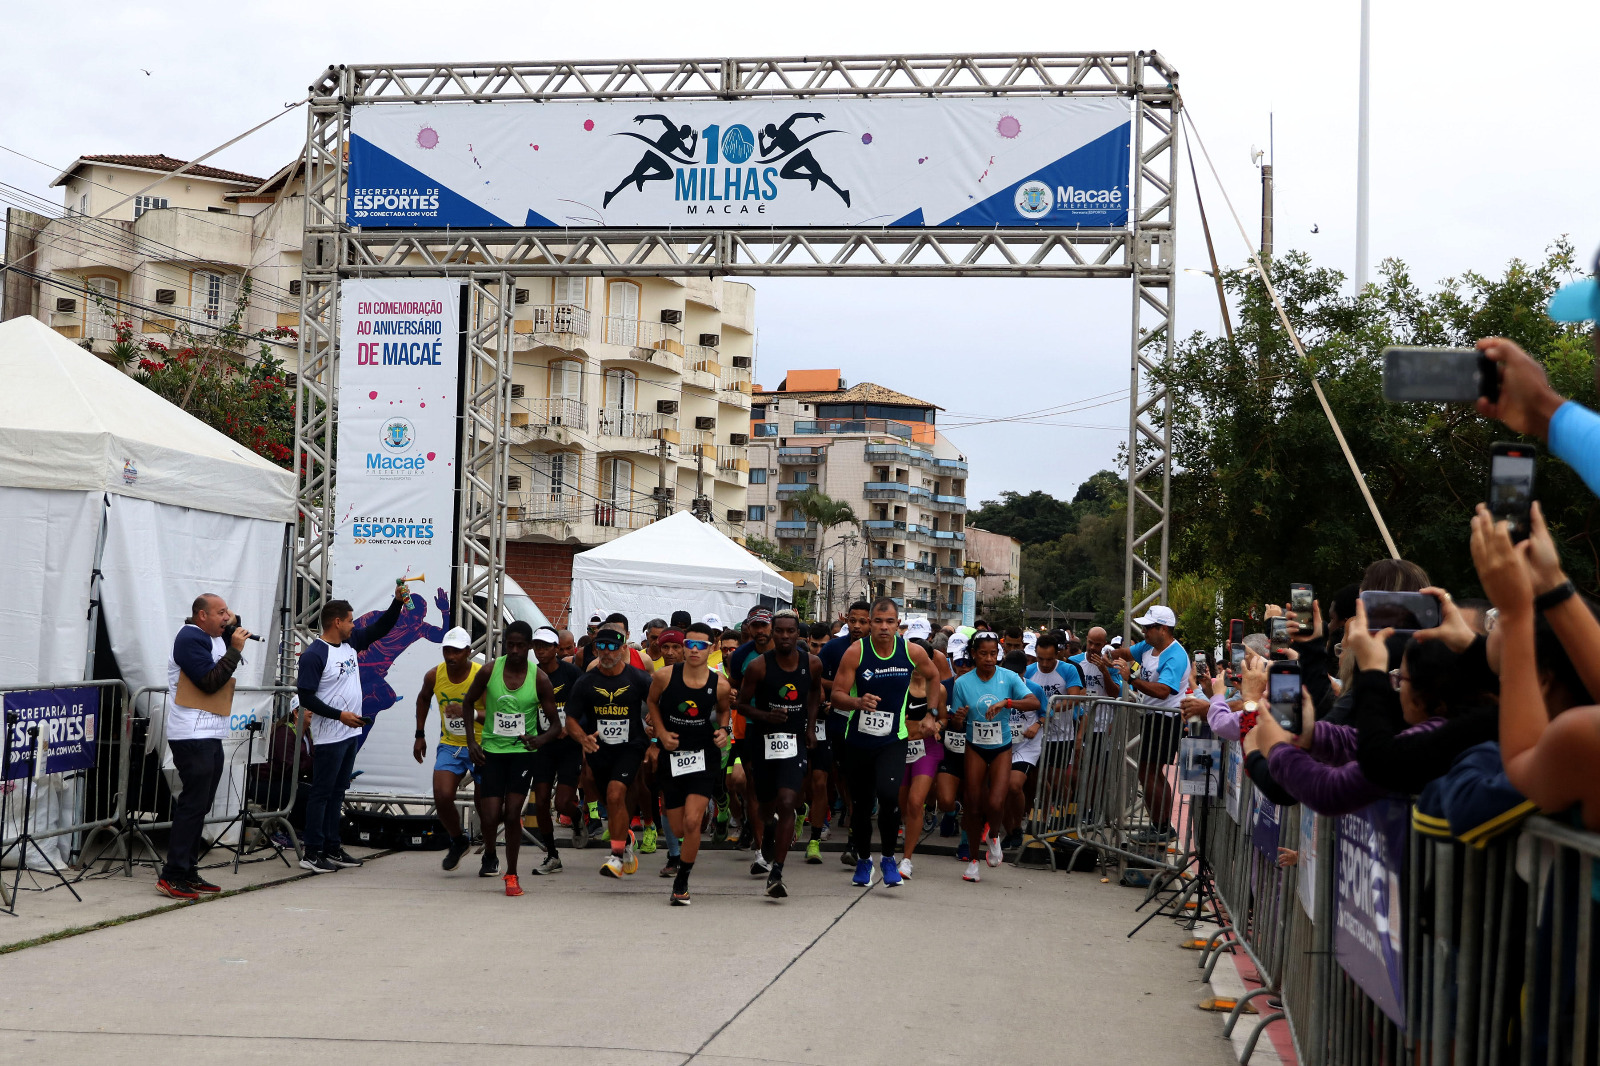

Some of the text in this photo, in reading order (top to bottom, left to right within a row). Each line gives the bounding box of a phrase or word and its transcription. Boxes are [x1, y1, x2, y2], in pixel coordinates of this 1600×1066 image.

[702, 124, 755, 165] 10
[675, 167, 778, 201] MILHAS
[354, 188, 419, 196] SECRETARIA
[1057, 186, 1122, 203] Macaé
[353, 195, 440, 210] ESPORTES
[687, 203, 766, 214] MACAÉ
[358, 299, 443, 317] EM COMEMORAÇÃO
[357, 317, 442, 335] AO ANIVERSÁRIO
[357, 337, 442, 366] DE MACAÉ
[366, 453, 425, 470] Macaé
[353, 516, 414, 524] SECRETARIA
[353, 523, 434, 539] ESPORTES
[7, 703, 84, 721] CRETARIA DE
[593, 705, 629, 716] PEGASUS
[231, 708, 257, 731] caé
[449, 720, 466, 729] 689
[498, 719, 518, 729] 384
[864, 716, 885, 728] 513
[603, 727, 622, 736] 692
[978, 728, 994, 738] 171
[770, 740, 789, 751] 808
[949, 737, 965, 747] 735
[56, 746, 67, 757] COM
[67, 743, 82, 754] VOCÊ
[677, 755, 697, 768] 802
